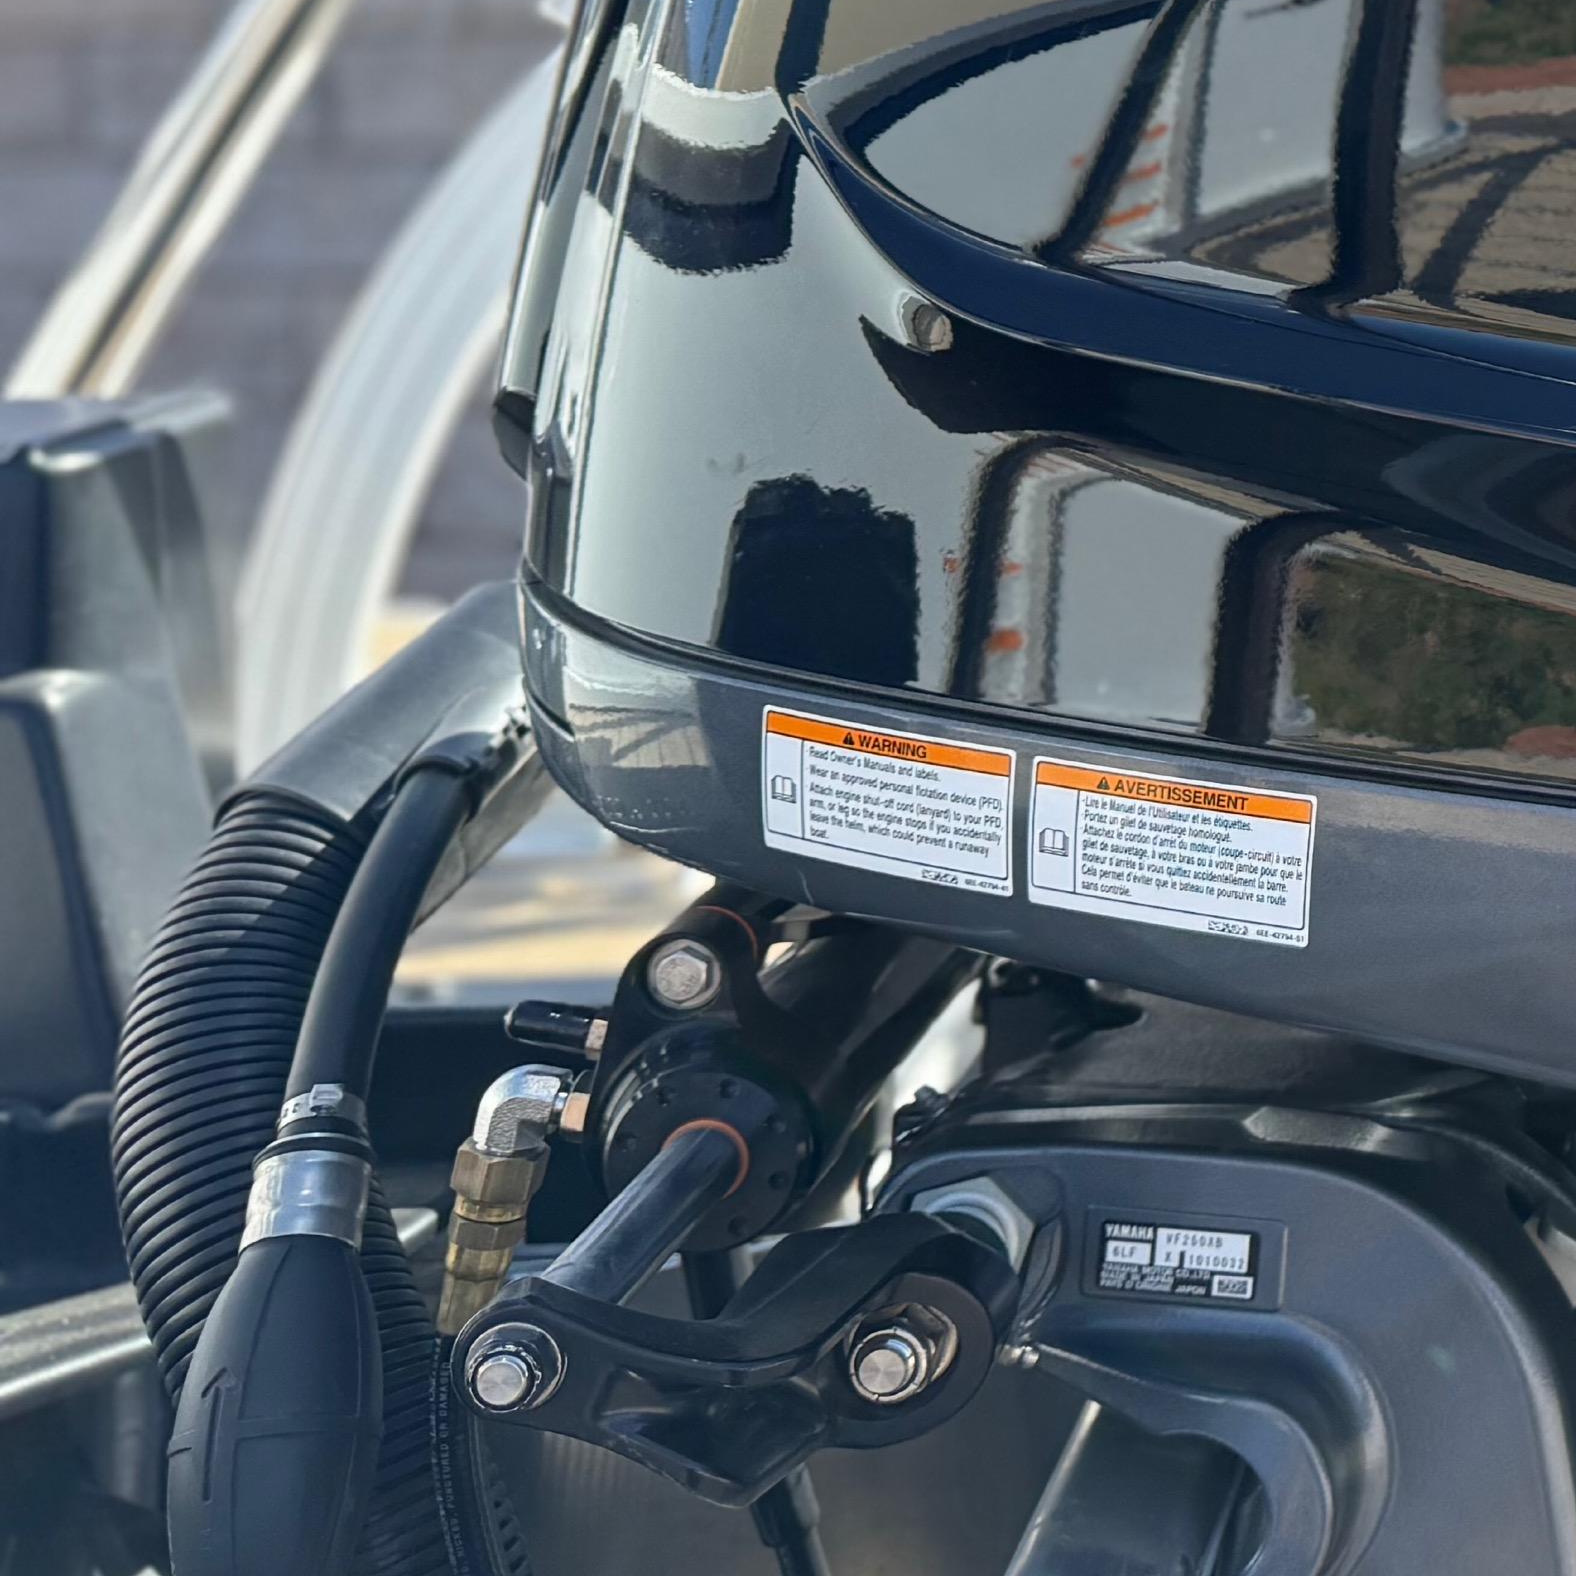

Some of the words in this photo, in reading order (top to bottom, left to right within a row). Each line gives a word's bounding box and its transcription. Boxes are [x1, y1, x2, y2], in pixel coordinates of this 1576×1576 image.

[858, 735, 927, 759] WARNING
[864, 757, 896, 774] Manuals
[898, 766, 913, 776] and
[830, 771, 839, 780] an
[842, 773, 878, 788] approved
[879, 780, 913, 794] personal
[916, 785, 948, 800] flotation
[950, 793, 976, 806] device
[1114, 779, 1249, 811] AVERTISSEMENT
[828, 803, 836, 811] or
[838, 803, 849, 819] leg
[851, 808, 860, 816] so
[863, 808, 874, 819] the
[877, 813, 902, 825] engine
[905, 818, 927, 830] stops
[929, 820, 934, 830] if
[937, 824, 950, 835] you
[953, 827, 1001, 846] accidentally
[835, 790, 861, 803] engine
[897, 802, 914, 813] cord
[953, 811, 961, 821] to
[964, 815, 982, 825] your
[1101, 800, 1107, 809] le
[1109, 800, 1135, 814] Manuel
[1138, 805, 1146, 815] de
[1192, 814, 1199, 824] et
[1201, 814, 1211, 825] les
[810, 811, 829, 824] leave
[831, 815, 843, 827] the
[868, 825, 890, 836] which
[892, 830, 914, 842] could
[916, 834, 946, 847] prevent
[948, 840, 953, 848] a
[955, 842, 989, 858] runaway
[1109, 817, 1118, 825] un
[1120, 816, 1136, 829] gilet
[1138, 819, 1147, 829] de
[1149, 823, 1186, 838] sauvetage
[1083, 838, 1098, 851] gilet
[1100, 841, 1108, 851] de
[1151, 849, 1156, 859] à
[1158, 852, 1176, 862] votre
[1179, 853, 1195, 865] bras
[1197, 858, 1206, 867] ou
[1208, 856, 1213, 868] à
[1215, 861, 1234, 871] votre
[1235, 861, 1258, 874] jambe
[1260, 866, 1278, 878] pour
[1280, 870, 1294, 881] que
[1296, 869, 1302, 880] le
[1117, 831, 1123, 840] le
[1125, 833, 1150, 844] cordon
[1179, 839, 1187, 850] du
[1190, 843, 1216, 854] moteur
[1276, 852, 1280, 863] à
[1283, 856, 1301, 866] votre
[1082, 853, 1107, 864] moteur
[1138, 862, 1145, 871] si
[1147, 864, 1164, 874] vous
[1166, 866, 1191, 878] quittez
[1258, 878, 1264, 889] la
[1082, 864, 1097, 876] Cela
[1099, 869, 1124, 881] permet
[1155, 878, 1168, 890] que
[1171, 879, 1177, 889] le
[1179, 880, 1204, 893] bateau
[1206, 886, 1215, 895] ne
[1217, 888, 1254, 901] poursuive
[1256, 894, 1264, 902] sa
[1267, 895, 1286, 906] route
[1082, 881, 1098, 891] sans
[1105, 1223, 1154, 1240] YAMAHA
